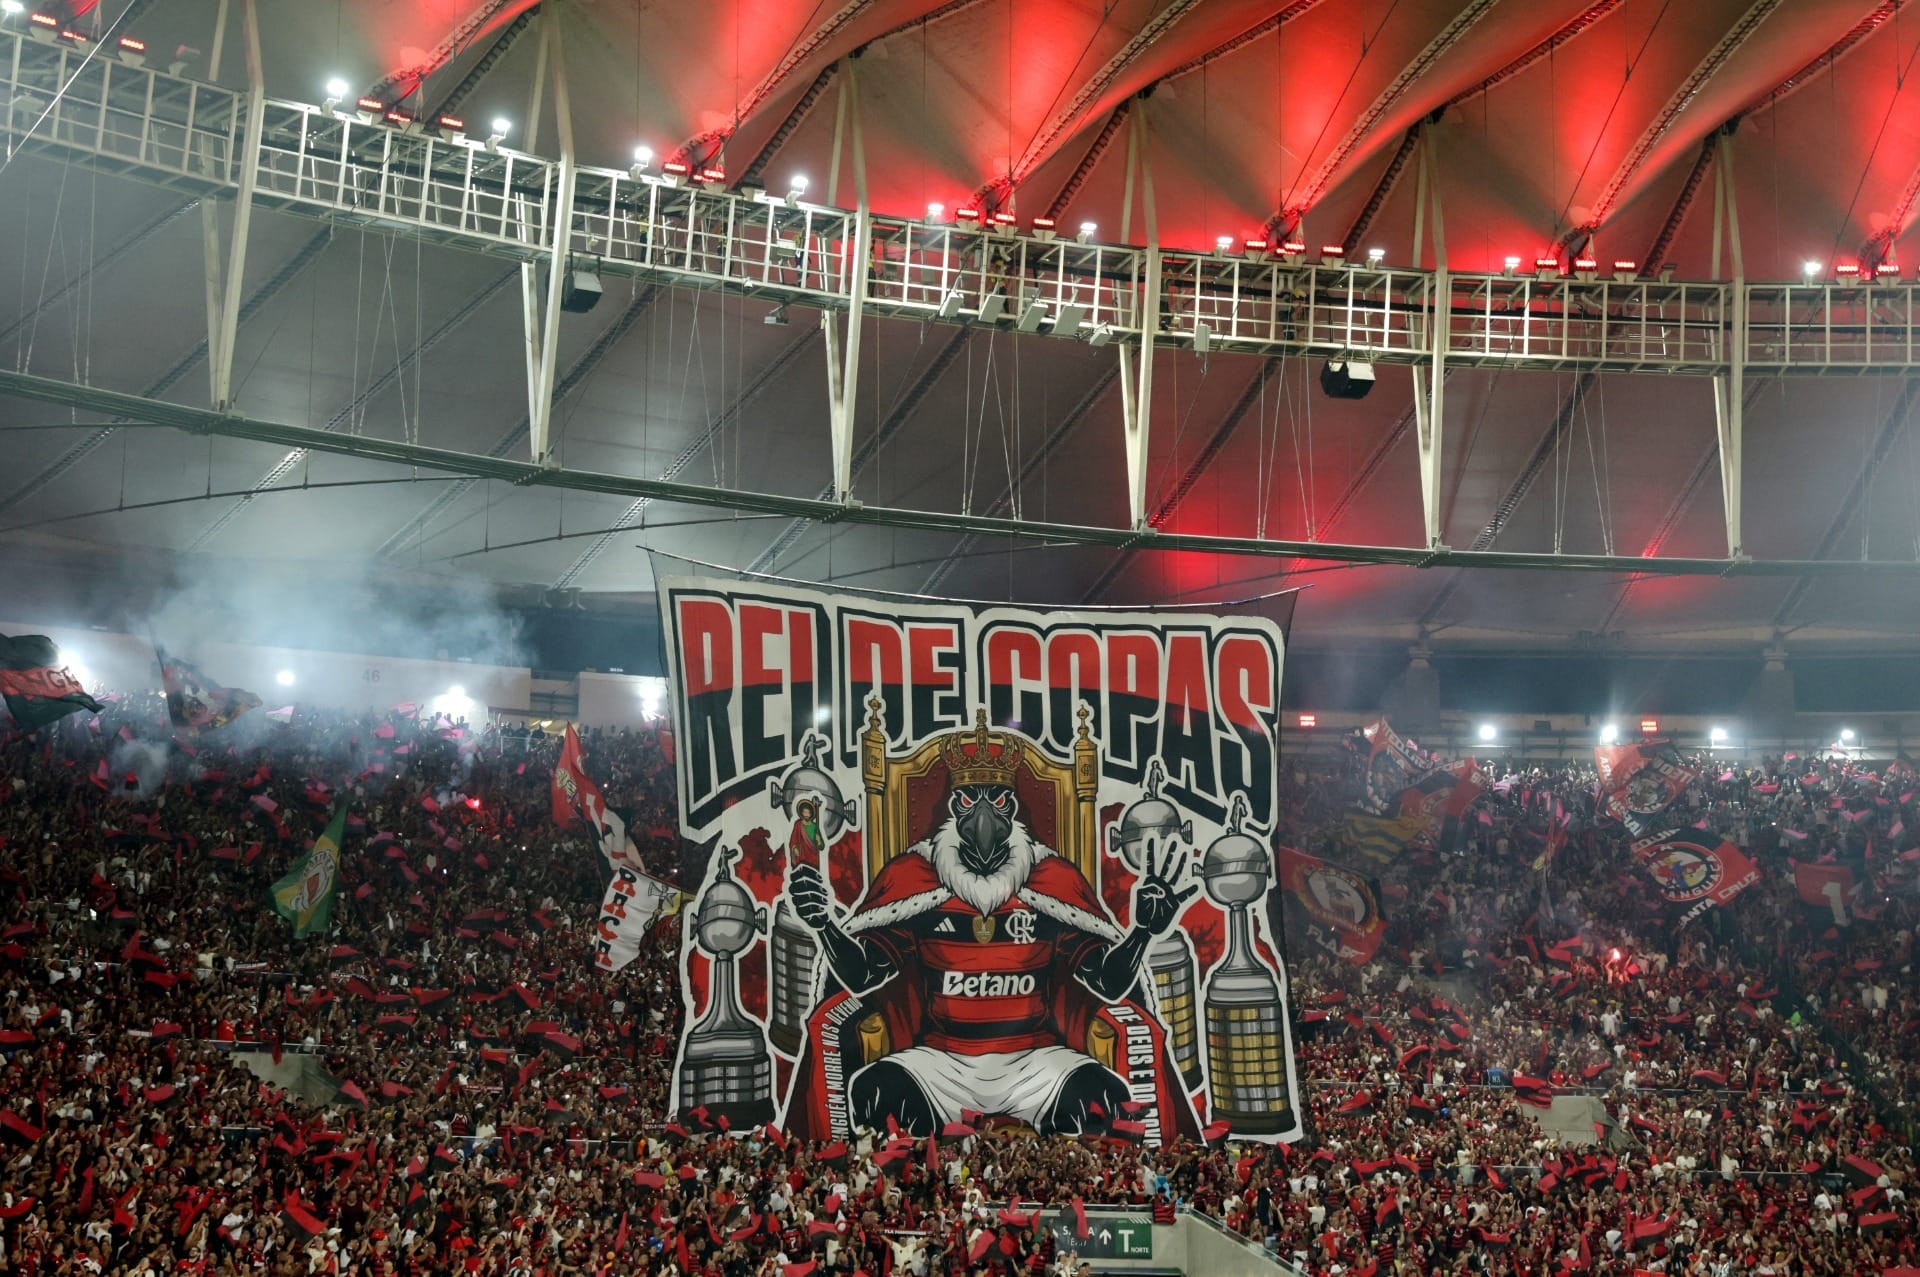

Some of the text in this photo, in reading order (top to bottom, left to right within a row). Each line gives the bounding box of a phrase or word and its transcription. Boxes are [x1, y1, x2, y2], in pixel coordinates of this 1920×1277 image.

[678, 598, 1273, 828] REI DE COPAS
[942, 970, 1036, 998] Betano
[1106, 1006, 1144, 1023] DE
[820, 1022, 841, 1048] NOS
[1126, 1025, 1155, 1066] DEUS
[823, 1050, 845, 1093] MORRE
[1128, 1069, 1156, 1079] E
[1130, 1082, 1157, 1102] DO
[825, 1094, 850, 1144] INGUÉM
[1118, 1224, 1135, 1253] T
[1131, 1246, 1149, 1254] NORTE
